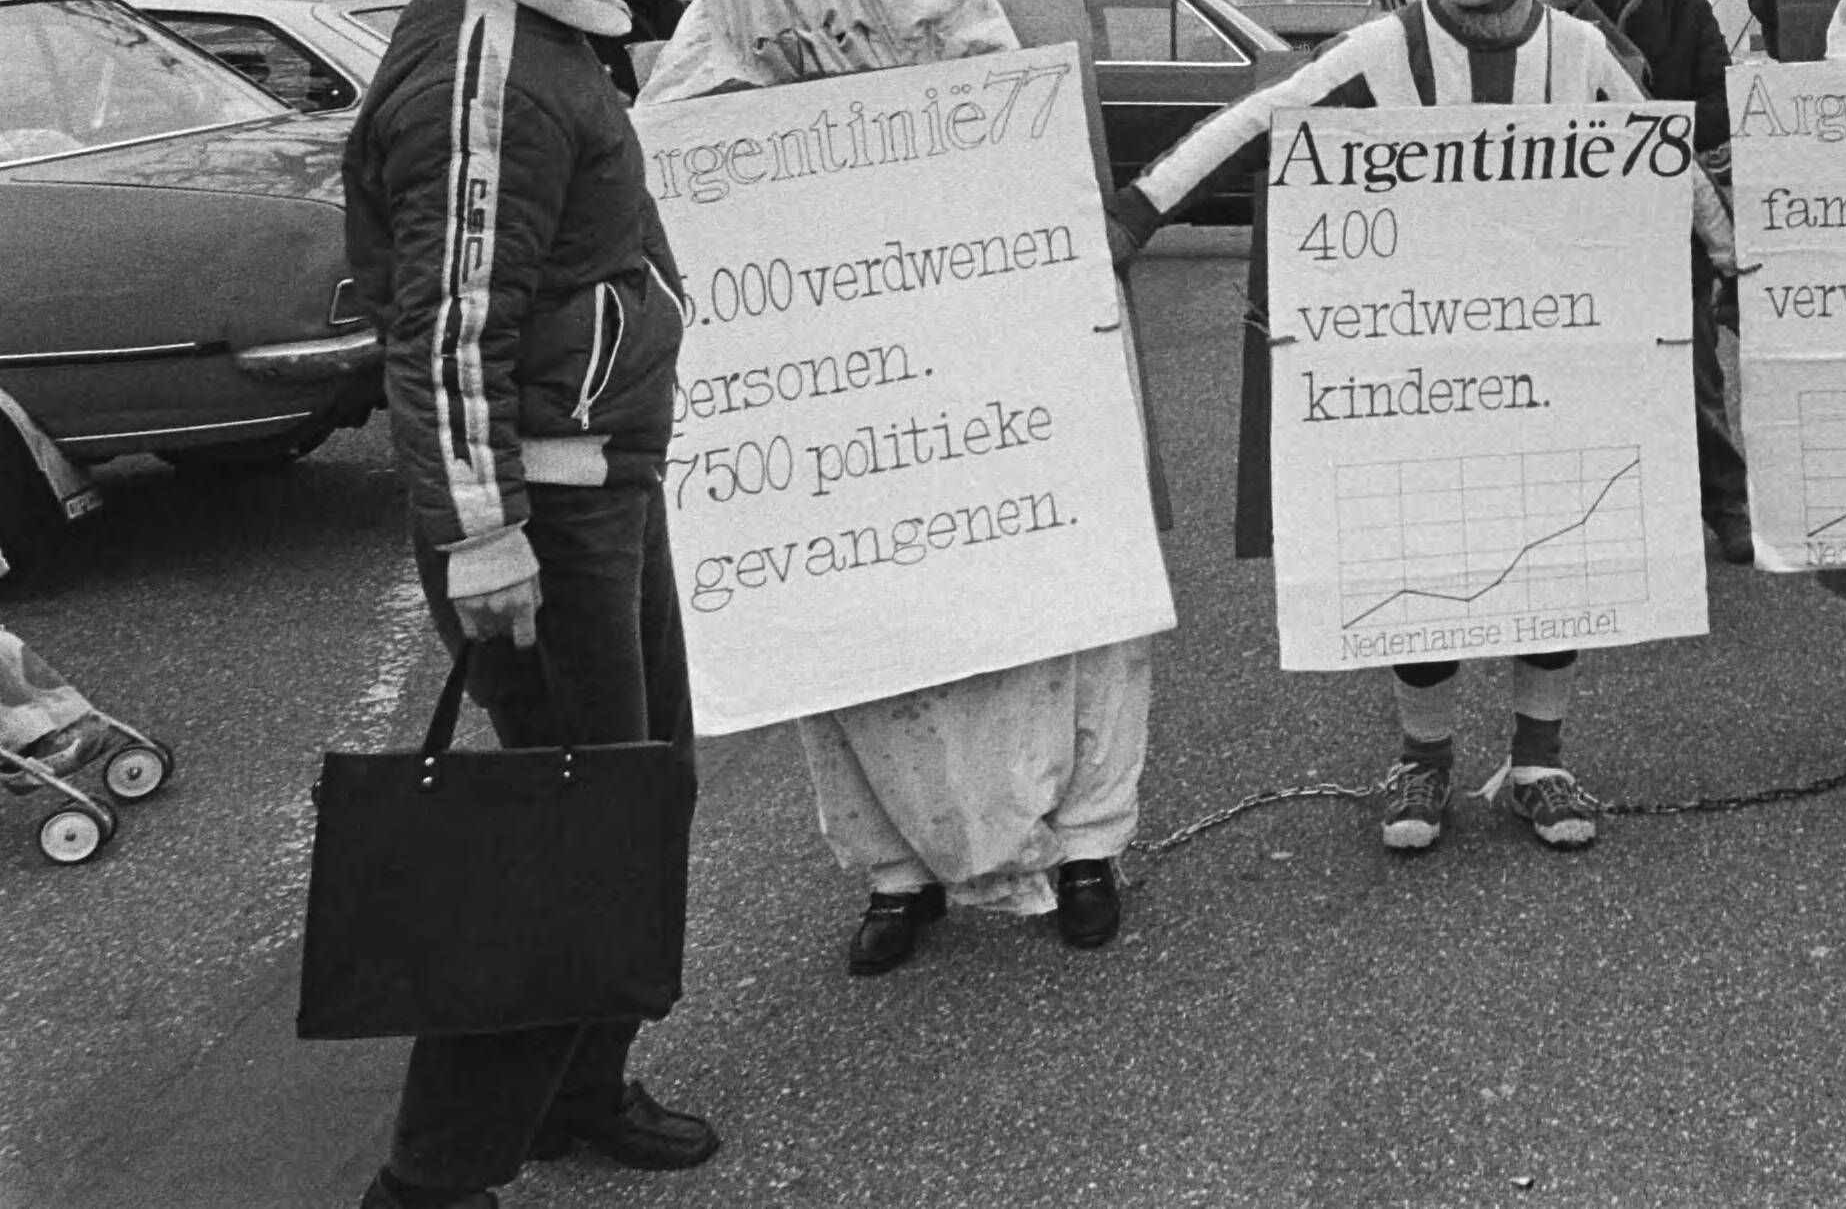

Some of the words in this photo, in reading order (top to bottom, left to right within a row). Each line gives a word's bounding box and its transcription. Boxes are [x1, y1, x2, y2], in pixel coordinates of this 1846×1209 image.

[1299, 207, 1399, 261] 400
[799, 225, 1080, 305] verdwenen
[1298, 289, 1601, 343] verdwenen
[1301, 368, 1552, 423] kinderen.
[665, 434, 794, 510] 7500
[805, 402, 1054, 498] politieke
[690, 491, 1079, 613] gevangenen.
[1339, 627, 1502, 661] Nederlanse
[1513, 610, 1622, 637] Handel
